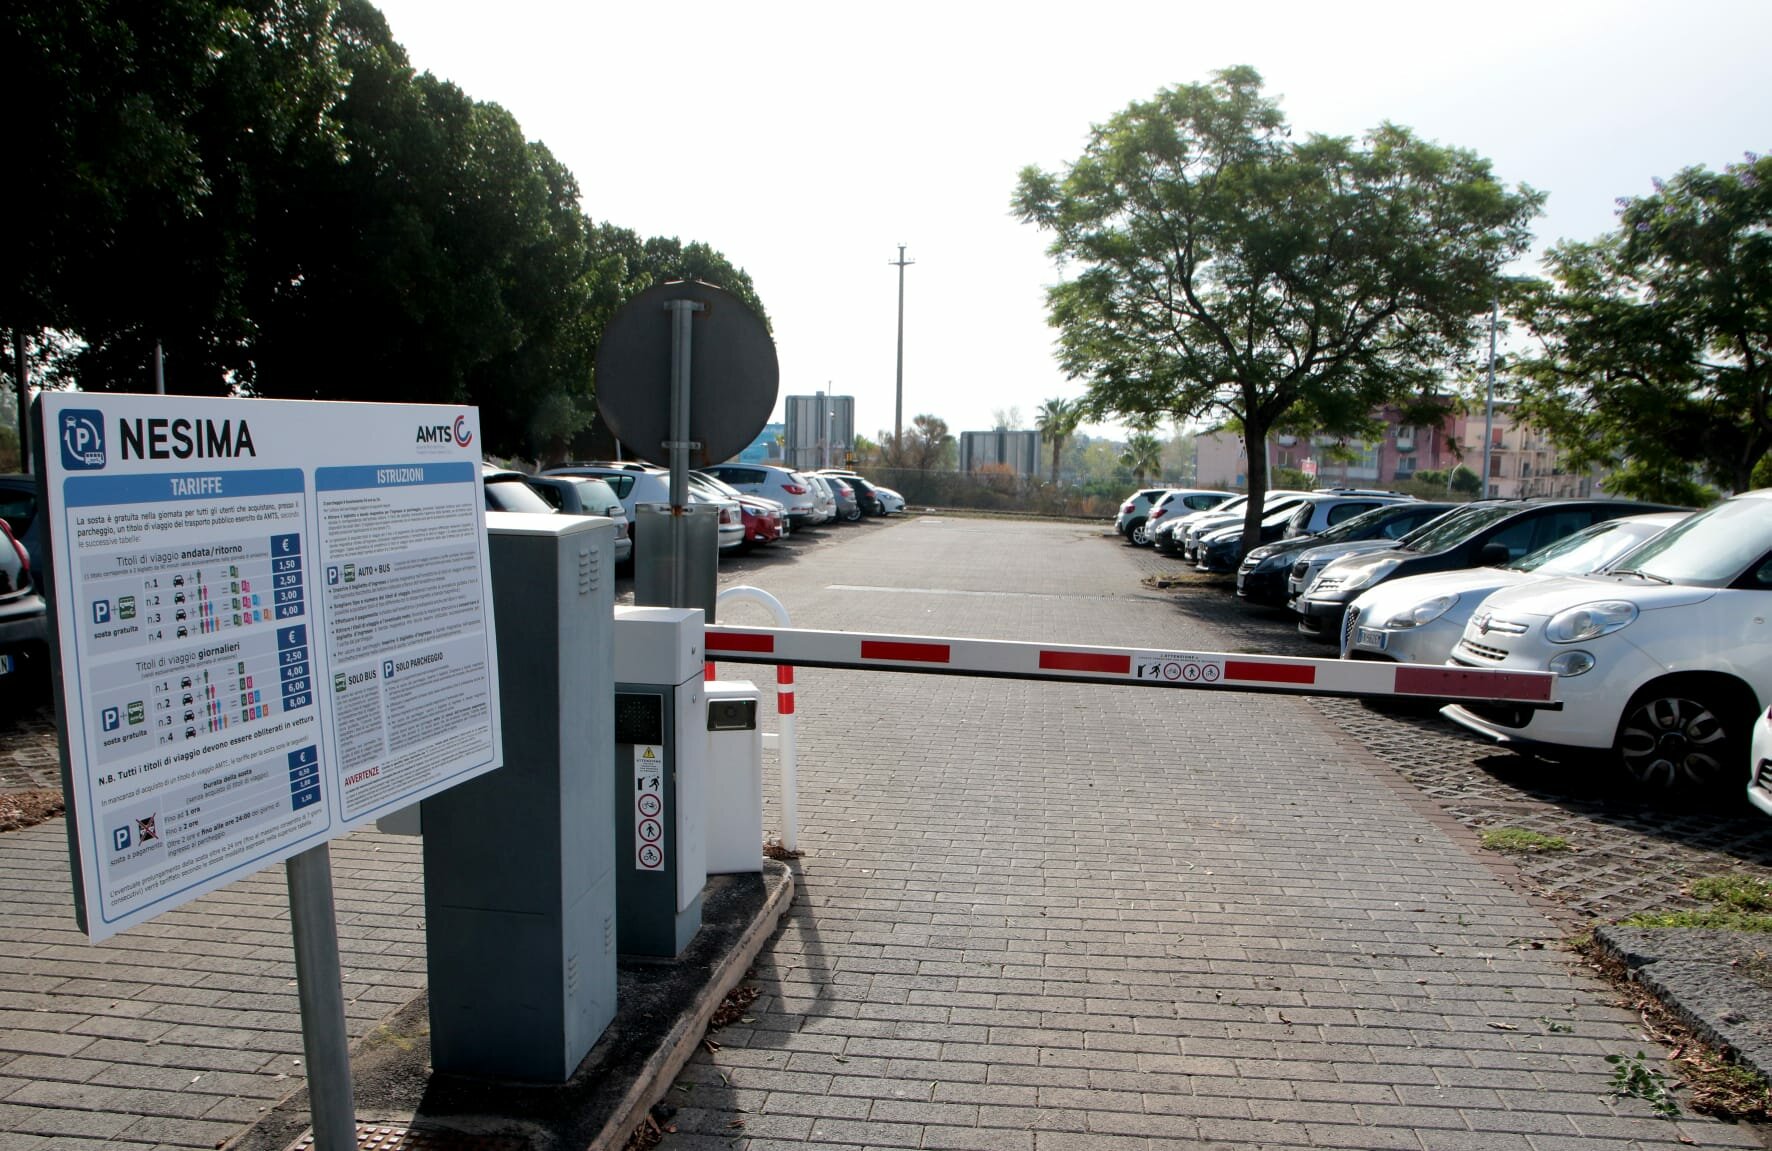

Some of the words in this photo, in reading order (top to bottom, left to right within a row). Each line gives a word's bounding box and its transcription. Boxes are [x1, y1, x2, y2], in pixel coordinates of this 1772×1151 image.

[119, 418, 256, 460] NESIMA
[416, 425, 452, 443] AMTS
[377, 468, 424, 484] ISTRUZIONI
[170, 476, 223, 496] TARIFFE
[76, 516, 84, 525] La
[88, 516, 104, 524] sosta
[107, 515, 112, 523] è
[114, 514, 138, 524] gratuita
[141, 512, 156, 520] nella
[158, 510, 182, 520] giornata
[196, 507, 208, 515] tutti
[219, 506, 235, 514] utenti
[77, 527, 115, 537] parcheggio,
[126, 524, 143, 532] titolo
[144, 523, 150, 531] di
[151, 521, 173, 531] viaggio
[174, 520, 183, 528] del
[184, 518, 210, 527] trasporto
[212, 517, 234, 526] pubblico
[263, 512, 279, 520] AMTS,
[86, 538, 118, 547] successive
[282, 538, 290, 552] €
[116, 556, 138, 567] Titoli
[140, 555, 148, 564] di
[150, 553, 179, 564] viaggio
[181, 545, 242, 559] andata/ritorno
[279, 560, 295, 570] 1,50
[358, 566, 373, 577] AUTO
[379, 564, 390, 573] BUS
[280, 575, 296, 586] 2,50
[329, 568, 337, 584] P
[144, 579, 158, 589] n.1
[146, 596, 160, 606] n.2
[281, 591, 297, 601] 3,00
[95, 603, 107, 622] P
[282, 606, 298, 616] 4,00
[147, 613, 161, 624] n.3
[94, 631, 111, 639] sosta
[113, 626, 139, 637] gratuita
[148, 630, 162, 641] n.4
[288, 630, 296, 644] €
[136, 659, 156, 671] Titoli
[158, 658, 166, 666] di
[168, 653, 197, 665] viaggio
[198, 641, 240, 660] giornalieri
[286, 651, 302, 662] 2,50
[395, 660, 410, 672] SOLO
[410, 652, 444, 668] PARCHEGGIO
[287, 666, 303, 677] 4,00
[386, 662, 392, 677] P
[348, 674, 364, 685] SOLO
[365, 670, 377, 681] BUS
[155, 682, 169, 694] n.1
[288, 681, 304, 693] 6,00
[157, 699, 170, 710] n.2
[289, 696, 306, 708] 8,00
[104, 710, 117, 730] P
[158, 716, 172, 727] n.3
[103, 737, 120, 747] sosta
[122, 730, 147, 742] gratuita
[160, 732, 173, 744] n.4
[98, 774, 116, 786] N.B.
[117, 767, 137, 780] Tutti
[143, 760, 162, 772] titoli
[164, 756, 171, 766] di
[173, 748, 201, 761] viaggio
[202, 741, 228, 754] devono
[229, 733, 252, 746] essere
[253, 725, 284, 739] obliterati
[284, 722, 291, 730] in
[292, 715, 314, 727] vettura
[203, 777, 222, 789] Durata
[223, 773, 237, 783] della
[238, 769, 252, 778] sosta
[345, 766, 379, 787] AVVERTENZE
[107, 791, 135, 804] mancanza
[141, 782, 163, 794] acquisto
[191, 807, 201, 815] ora
[188, 820, 199, 828] ore
[201, 827, 213, 836] fino
[214, 823, 224, 831] alle
[225, 819, 234, 827] ore
[235, 812, 251, 823] 24:00
[116, 830, 128, 849] P
[168, 845, 191, 857] ingresso
[197, 831, 225, 847] parcheggio
[133, 842, 163, 858] pagamento
